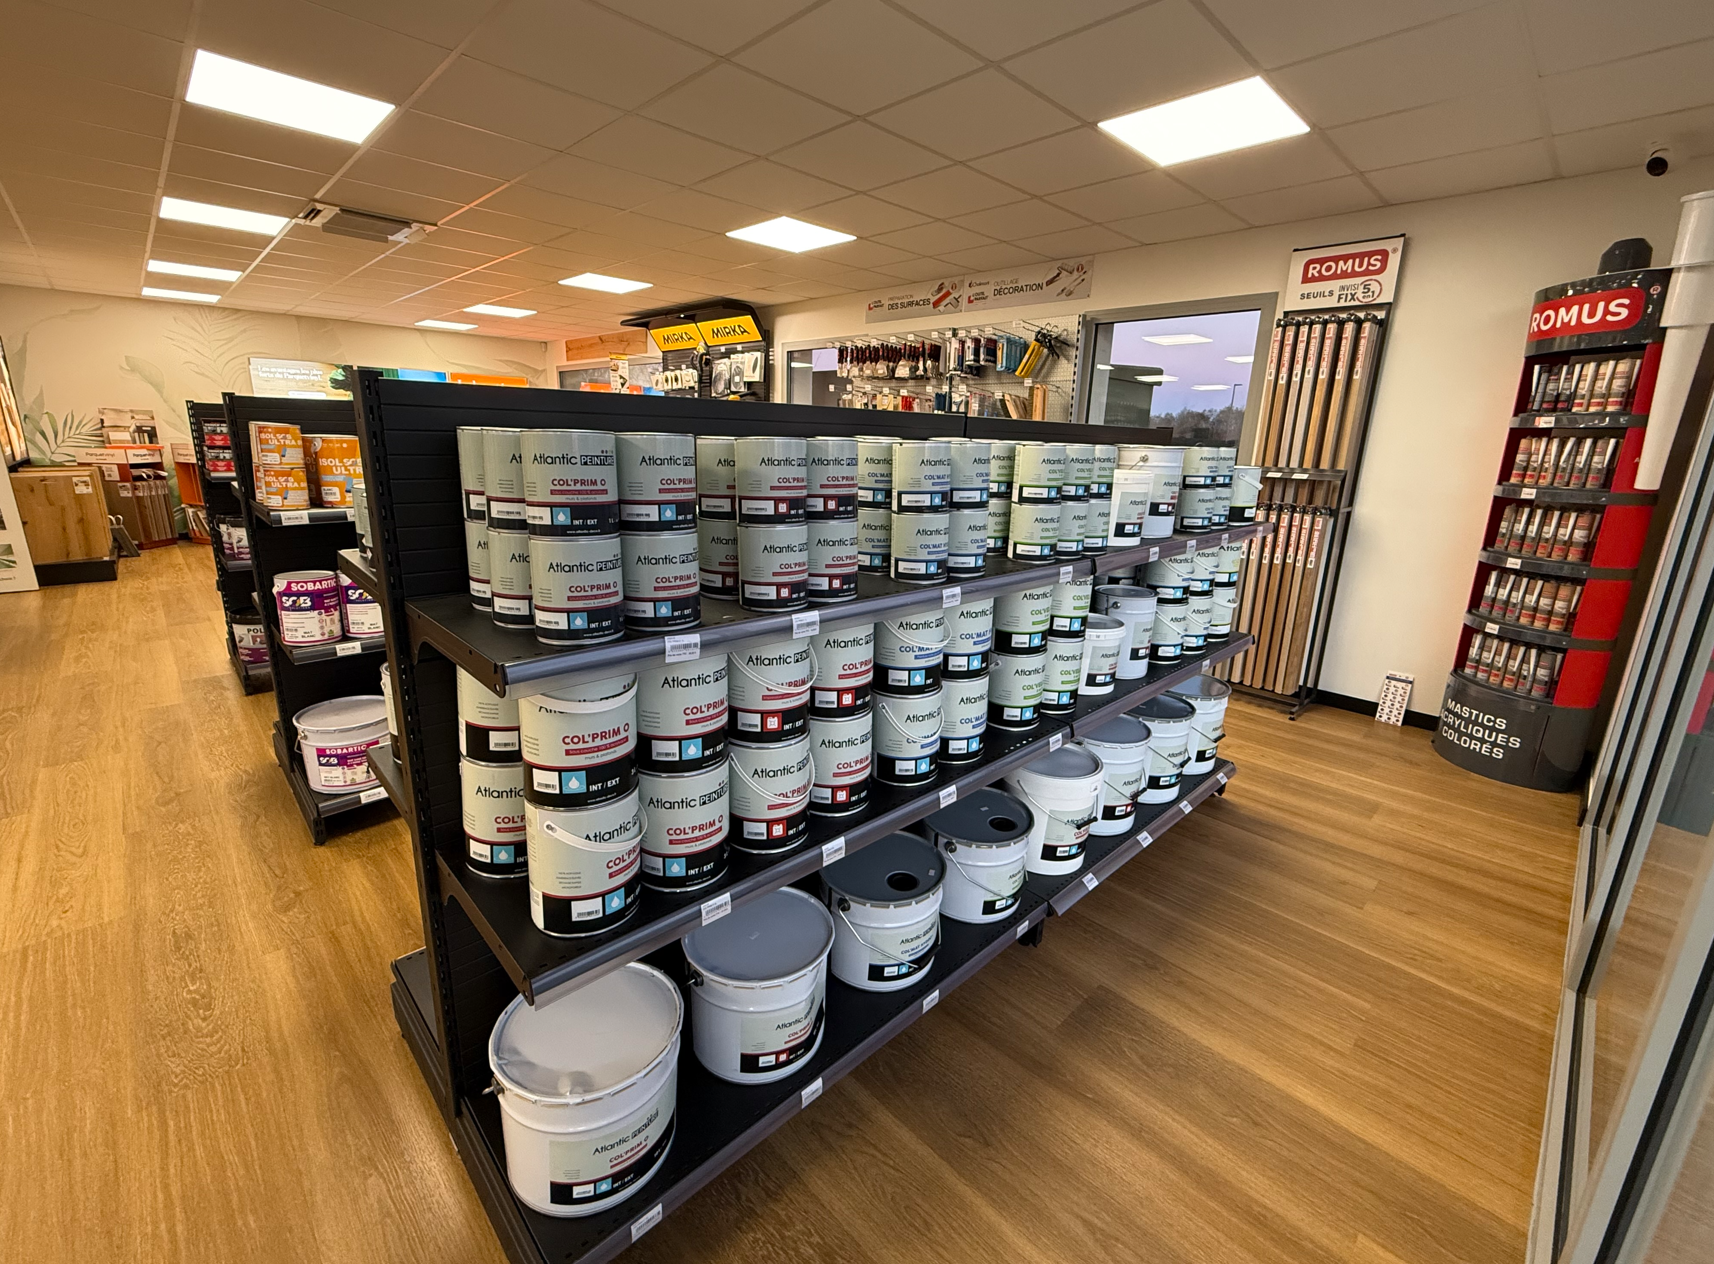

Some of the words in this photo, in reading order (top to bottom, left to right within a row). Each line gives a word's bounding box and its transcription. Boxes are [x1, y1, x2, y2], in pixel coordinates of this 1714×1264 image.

[1308, 255, 1382, 278] ROMUS
[993, 282, 1044, 296] DÉCORATION
[1338, 283, 1359, 292] INVISI
[1300, 290, 1334, 300] SEUILS
[1337, 292, 1357, 303] FIX
[888, 302, 899, 310] DES
[900, 298, 931, 309] SURFACES
[1530, 298, 1631, 333] ROMUS
[663, 331, 696, 344] MIRKA
[712, 324, 751, 339] MIRKA
[532, 453, 578, 466] Atlantic
[639, 456, 681, 466] Atlantic
[759, 457, 795, 466] Atlantic
[810, 457, 845, 466] Atlantic
[862, 523, 889, 531] Atlantic
[816, 538, 848, 546] Atlantic
[762, 544, 797, 554] Atlantic
[636, 555, 678, 566] Atlantic
[548, 561, 594, 573] Atlantic
[291, 578, 336, 591] SOBARTIC
[655, 575, 691, 584] COL'PRIM
[569, 582, 611, 593] COL'PRIM
[1022, 591, 1049, 600] Atlantic
[959, 608, 989, 619] Atlantic
[898, 620, 934, 631] Atlantic
[960, 631, 988, 640] COL'MAT
[824, 637, 863, 648] Atlantic
[747, 654, 792, 666] Atlantic
[1014, 667, 1041, 676] Atlantic
[661, 673, 712, 688] Atlantic
[683, 700, 725, 716] COL'PRIM
[1447, 698, 1507, 729] MASTICS
[905, 710, 937, 723] Atlantic
[960, 714, 985, 724] COL'MAT
[562, 727, 621, 745] COL'PRIM
[623, 722, 629, 732] O
[819, 738, 859, 749] Atlantic
[1442, 726, 1504, 759] COLORÉS
[326, 745, 367, 754] SOBARTIC
[704, 748, 713, 756] INT
[836, 756, 869, 769] COL'PRIM
[752, 764, 795, 779] Atlantic
[589, 783, 602, 792] INT
[607, 777, 620, 787] EXT
[648, 796, 697, 810] Atlantic
[666, 821, 716, 836] COL'PRIM
[718, 815, 724, 824] O
[704, 862, 715, 872] EXT
[775, 1017, 803, 1031] Atlantic
[593, 1136, 630, 1155] Atlantic
[609, 1141, 642, 1163] COL'PRIM
